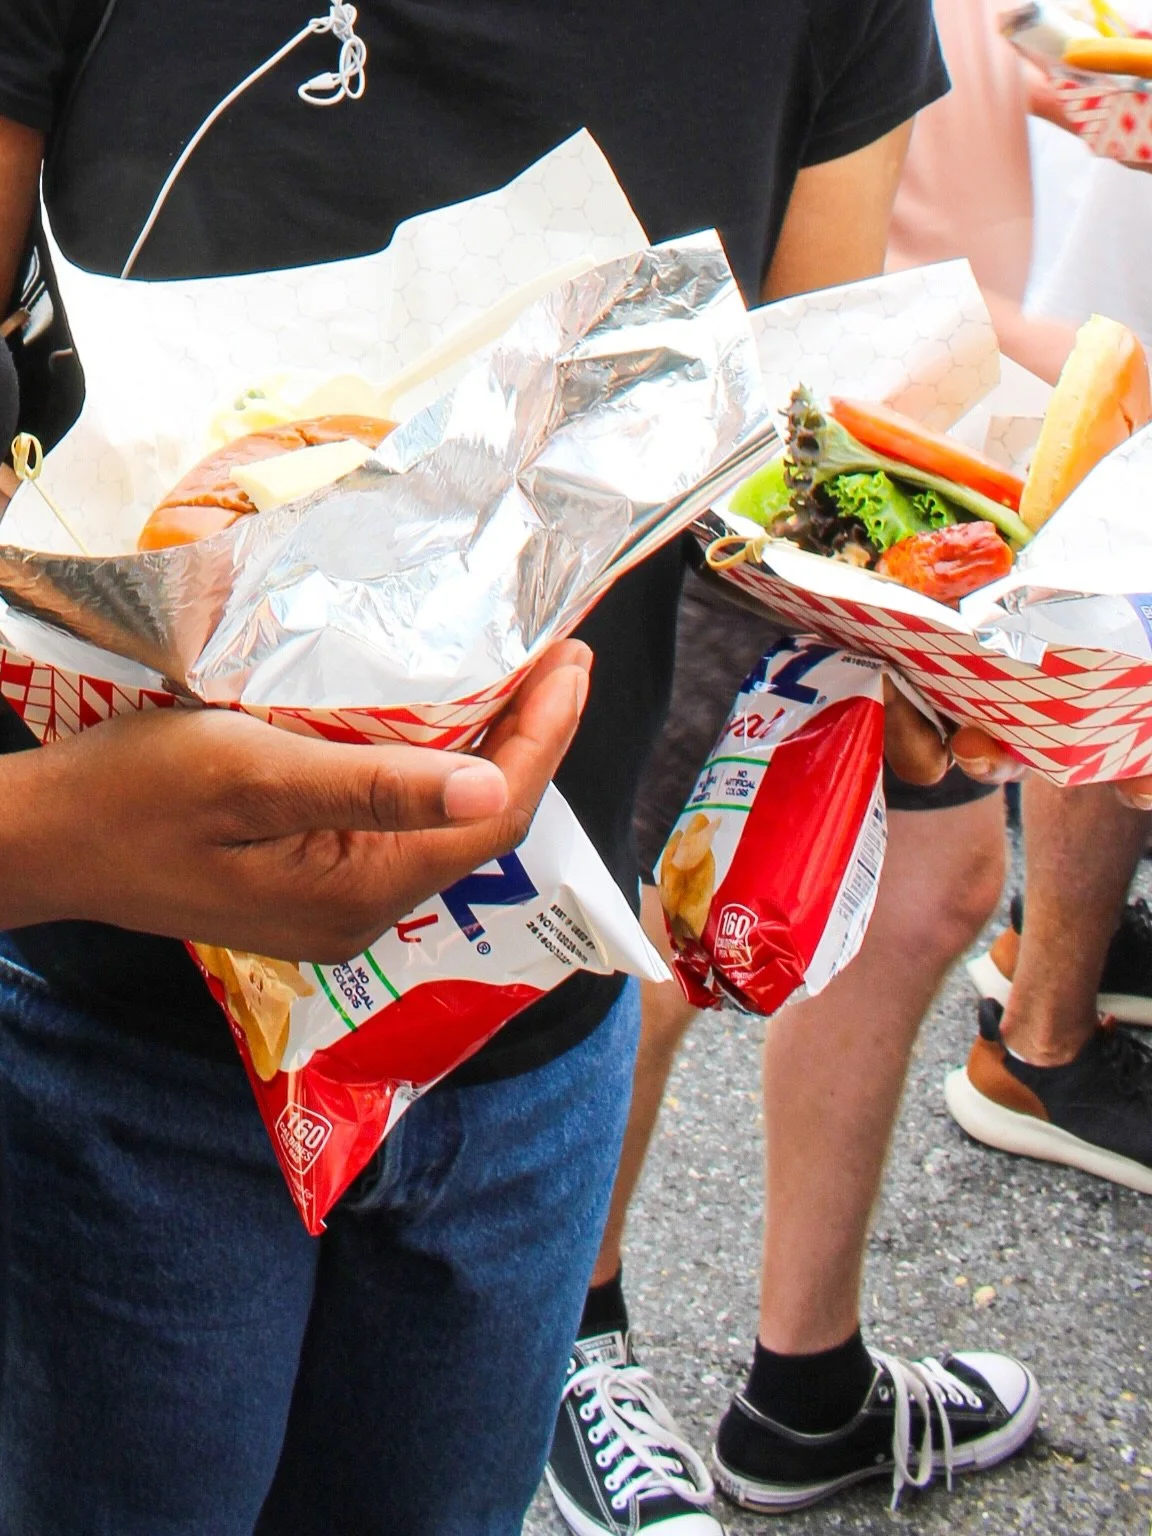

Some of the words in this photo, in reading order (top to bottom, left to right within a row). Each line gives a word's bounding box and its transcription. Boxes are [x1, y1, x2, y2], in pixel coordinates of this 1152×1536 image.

[721, 911, 751, 940] 160
[332, 967, 362, 1010] COLORS
[339, 962, 374, 1011] RTIFICIAL
[354, 966, 370, 985] NO
[287, 1110, 326, 1150] 160
